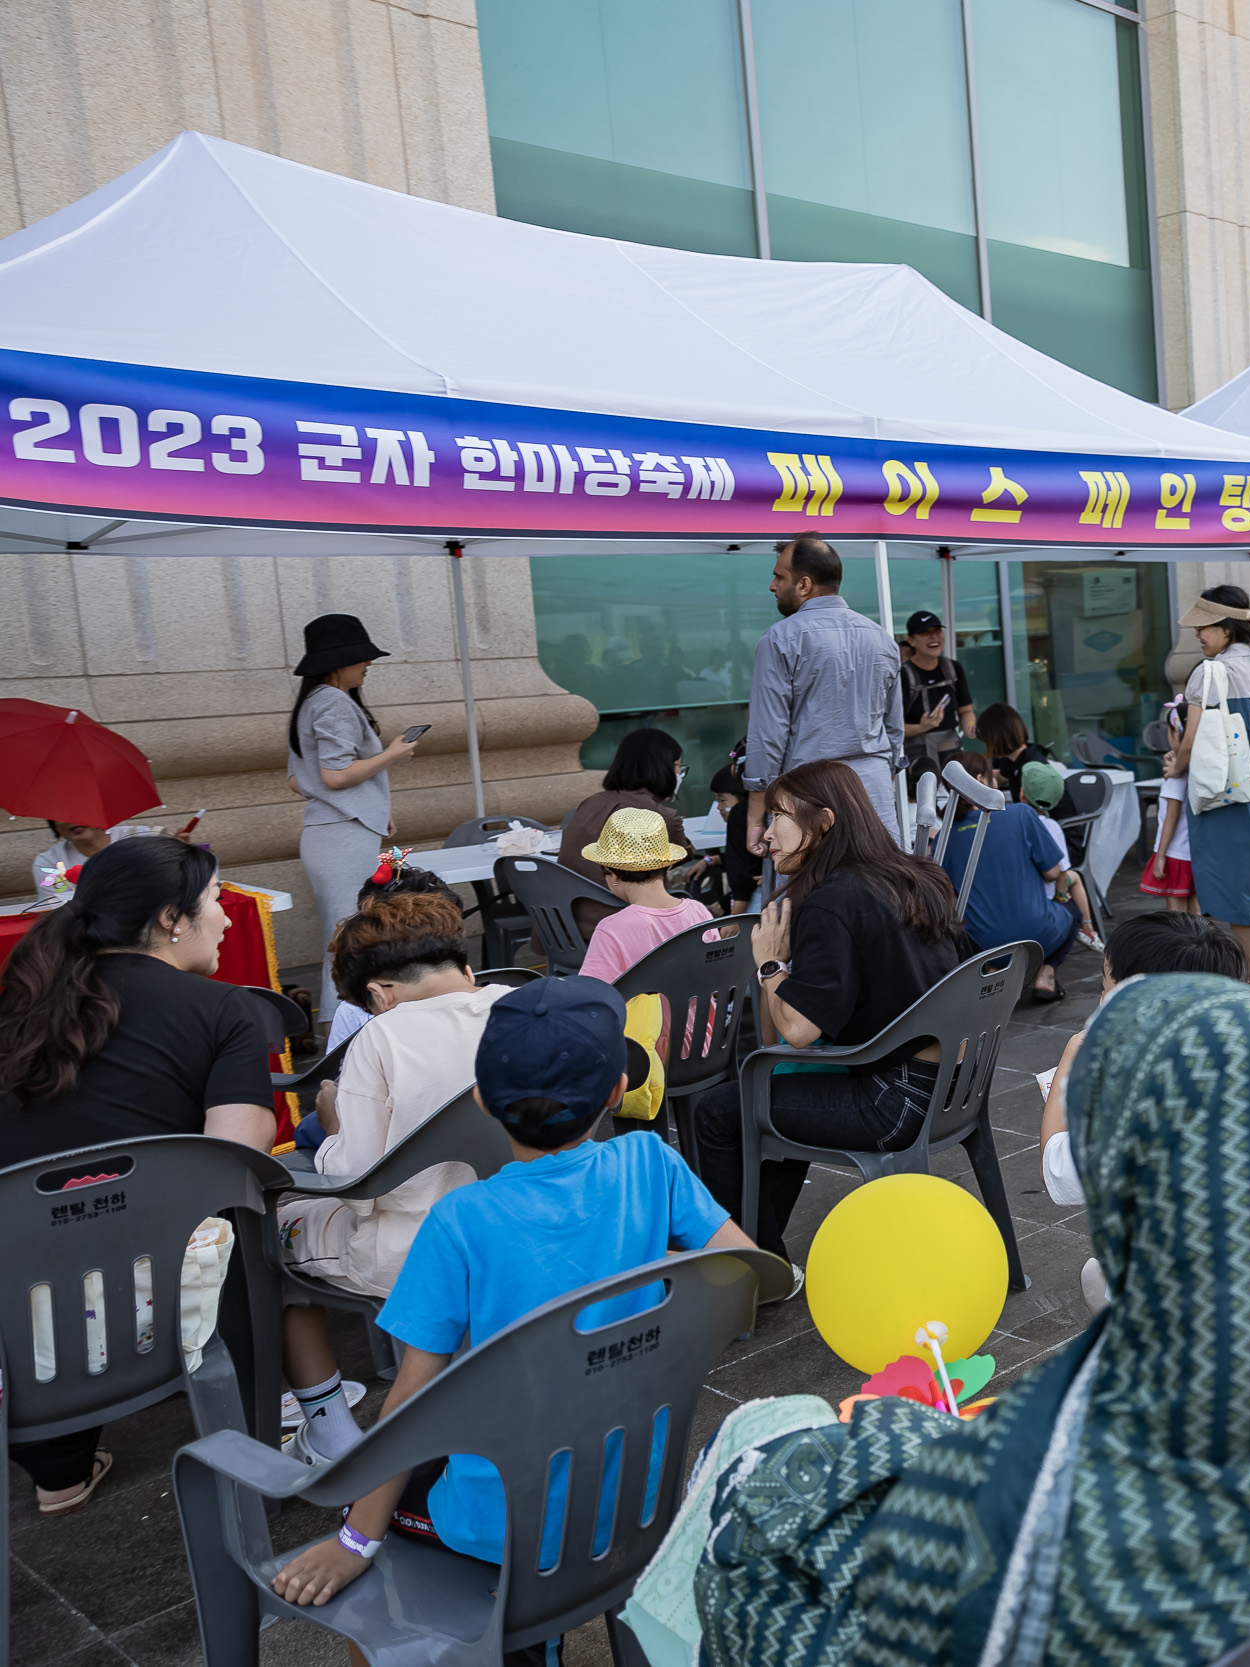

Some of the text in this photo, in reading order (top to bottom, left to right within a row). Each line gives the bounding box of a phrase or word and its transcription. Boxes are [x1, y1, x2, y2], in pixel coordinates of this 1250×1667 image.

[9, 397, 265, 476] 2023
[295, 420, 435, 488] 군자
[454, 434, 736, 502] 한마당축제
[51, 1191, 126, 1219] 렌탈 천하
